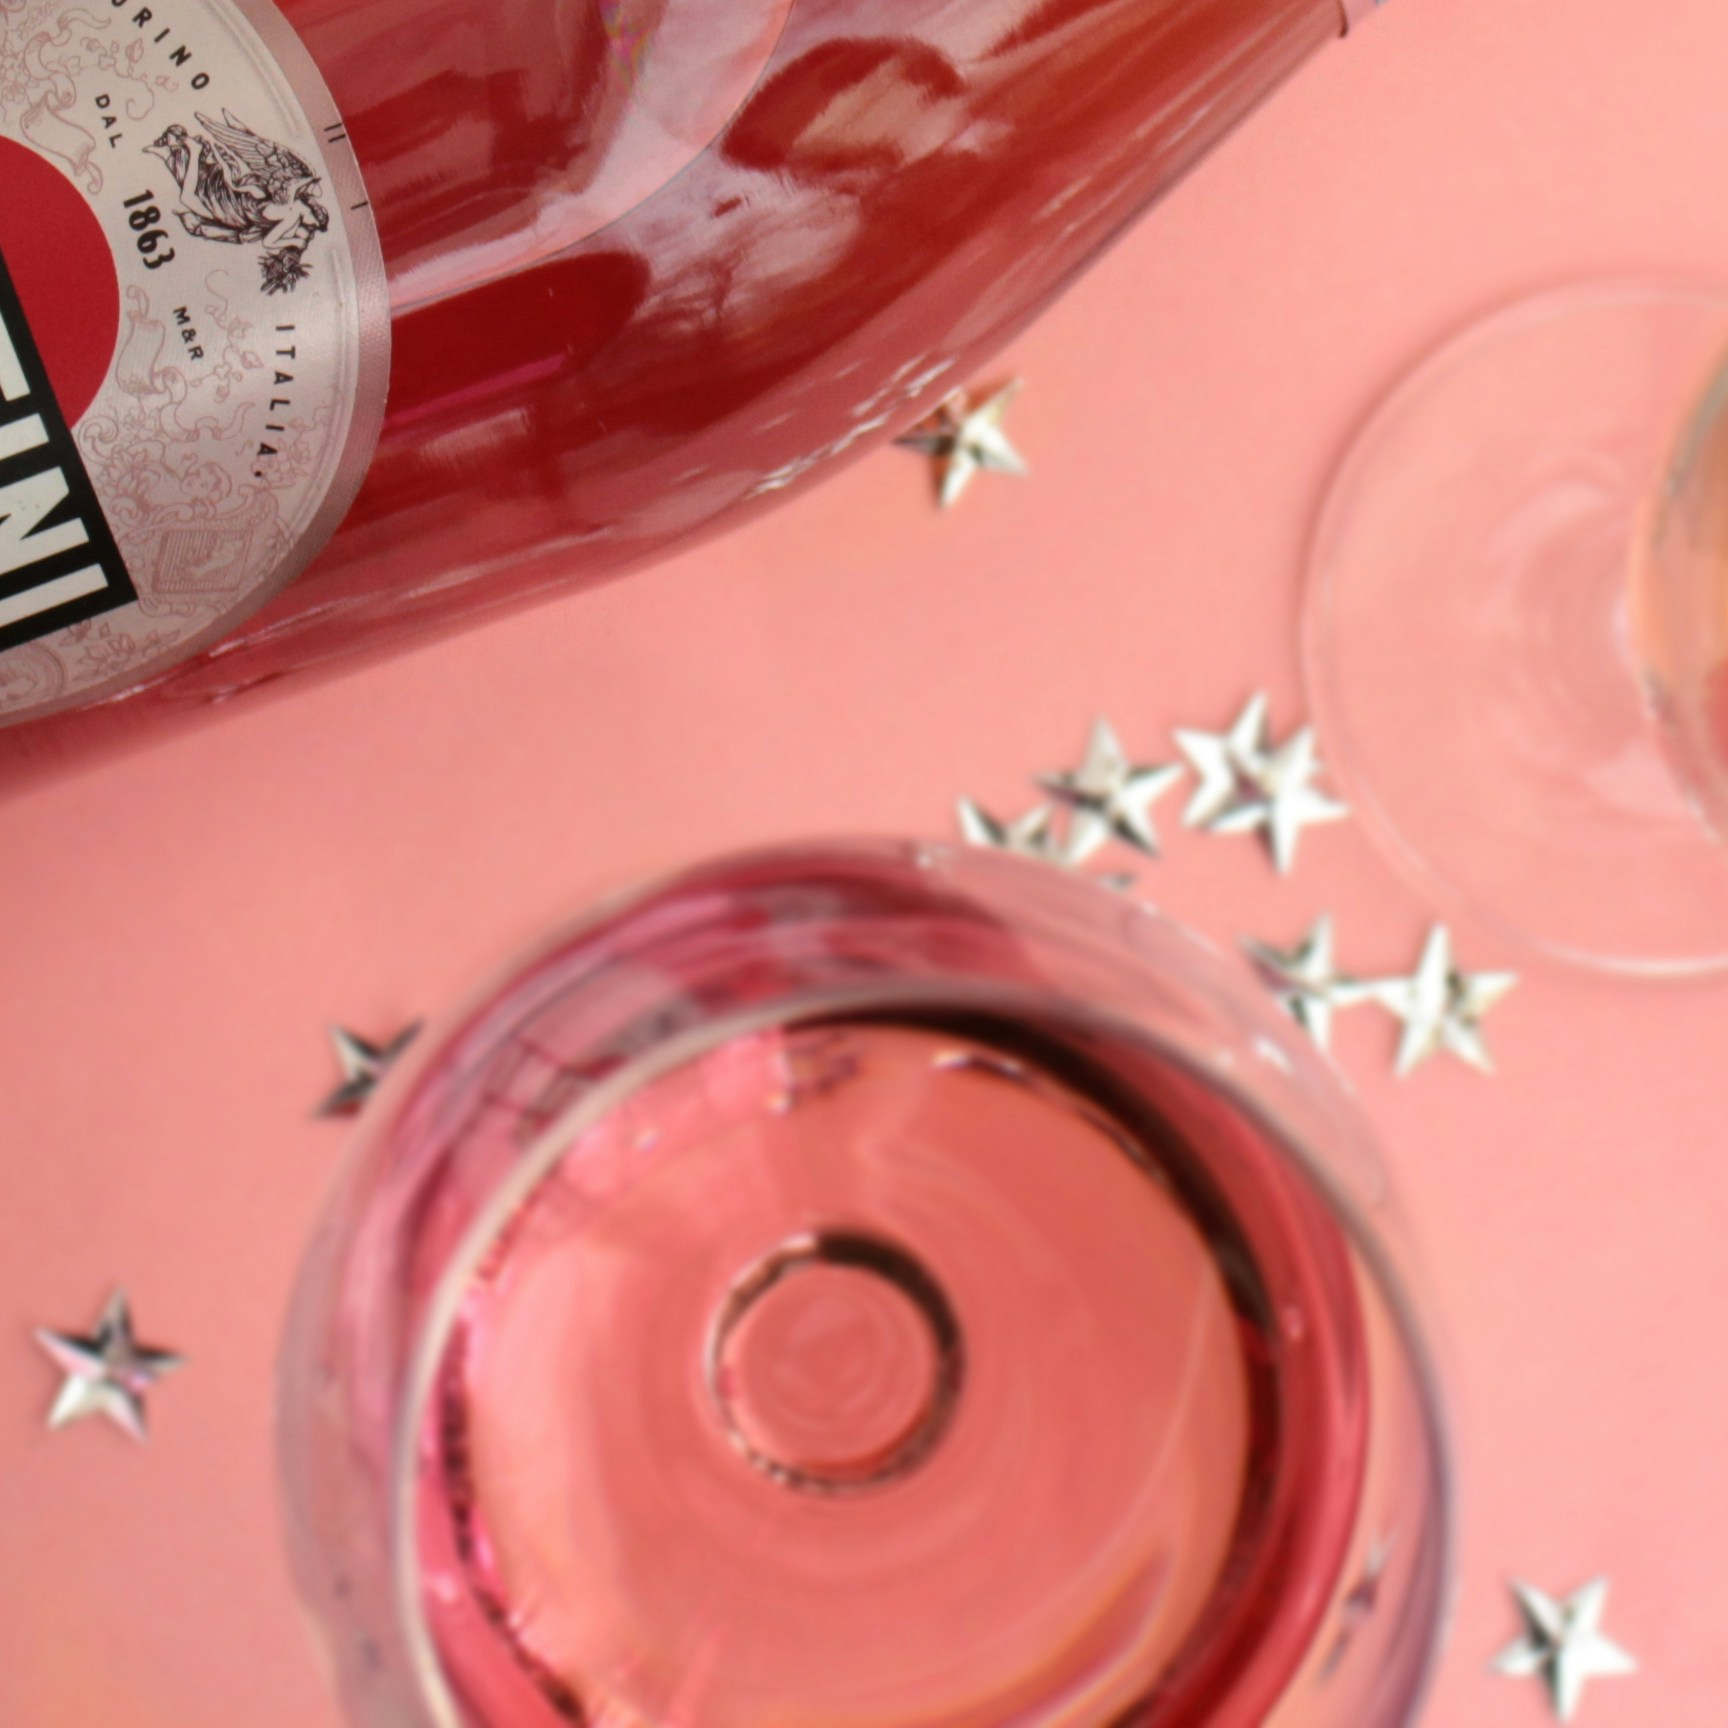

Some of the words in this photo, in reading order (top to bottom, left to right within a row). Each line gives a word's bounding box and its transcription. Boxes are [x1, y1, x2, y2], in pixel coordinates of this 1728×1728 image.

[94, 93, 124, 149] DAL
[123, 188, 176, 270] 1863
[173, 306, 205, 361] M&R
[256, 325, 297, 457] ITALIA
